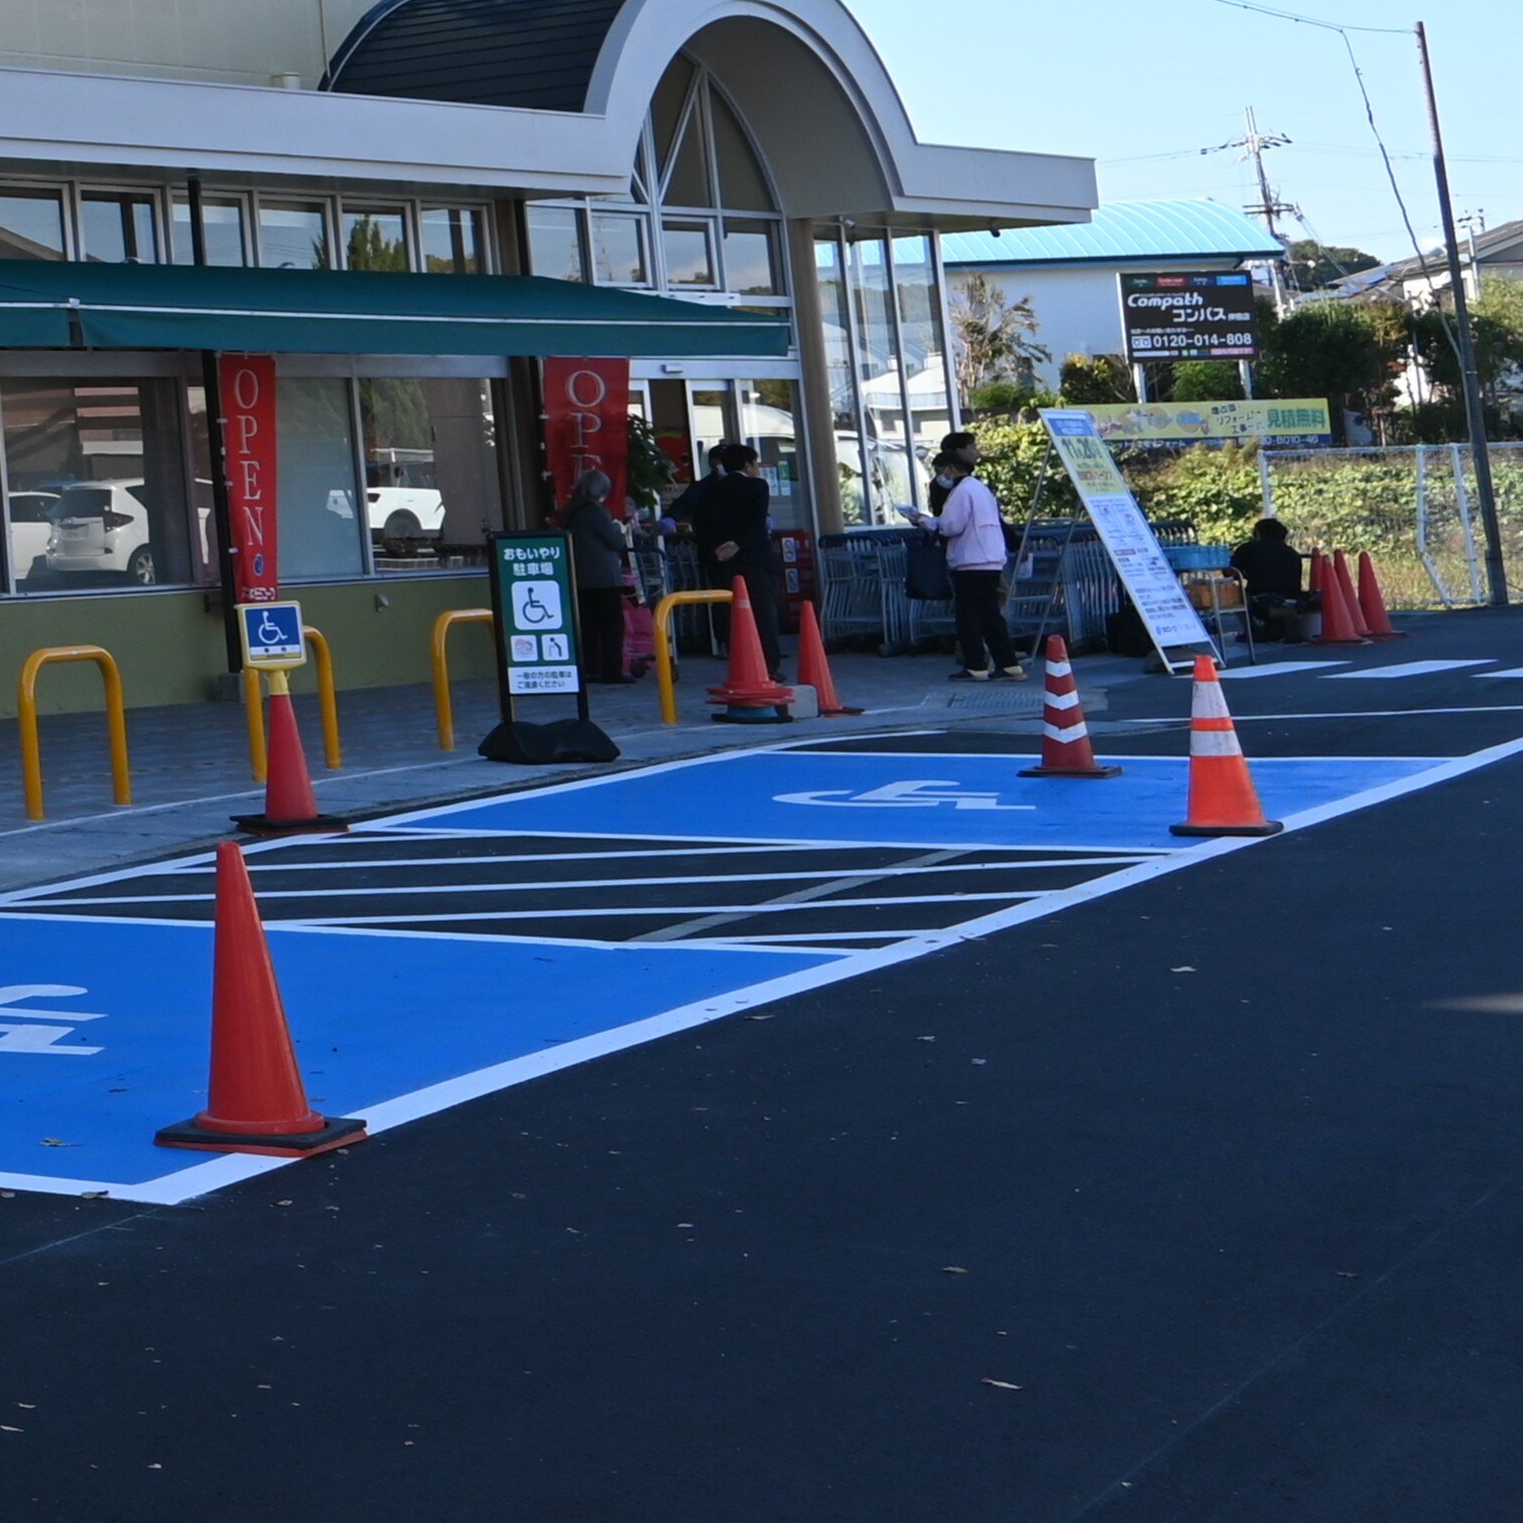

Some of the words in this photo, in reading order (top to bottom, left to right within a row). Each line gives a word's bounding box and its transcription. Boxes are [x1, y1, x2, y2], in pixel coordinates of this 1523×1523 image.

[1127, 291, 1203, 311] Compath
[1154, 333, 1252, 348] 0120-014-808
[565, 370, 606, 489] OPE
[234, 368, 264, 546] OPEN
[503, 546, 561, 560] おもいやり
[513, 562, 554, 576] 駐車場
